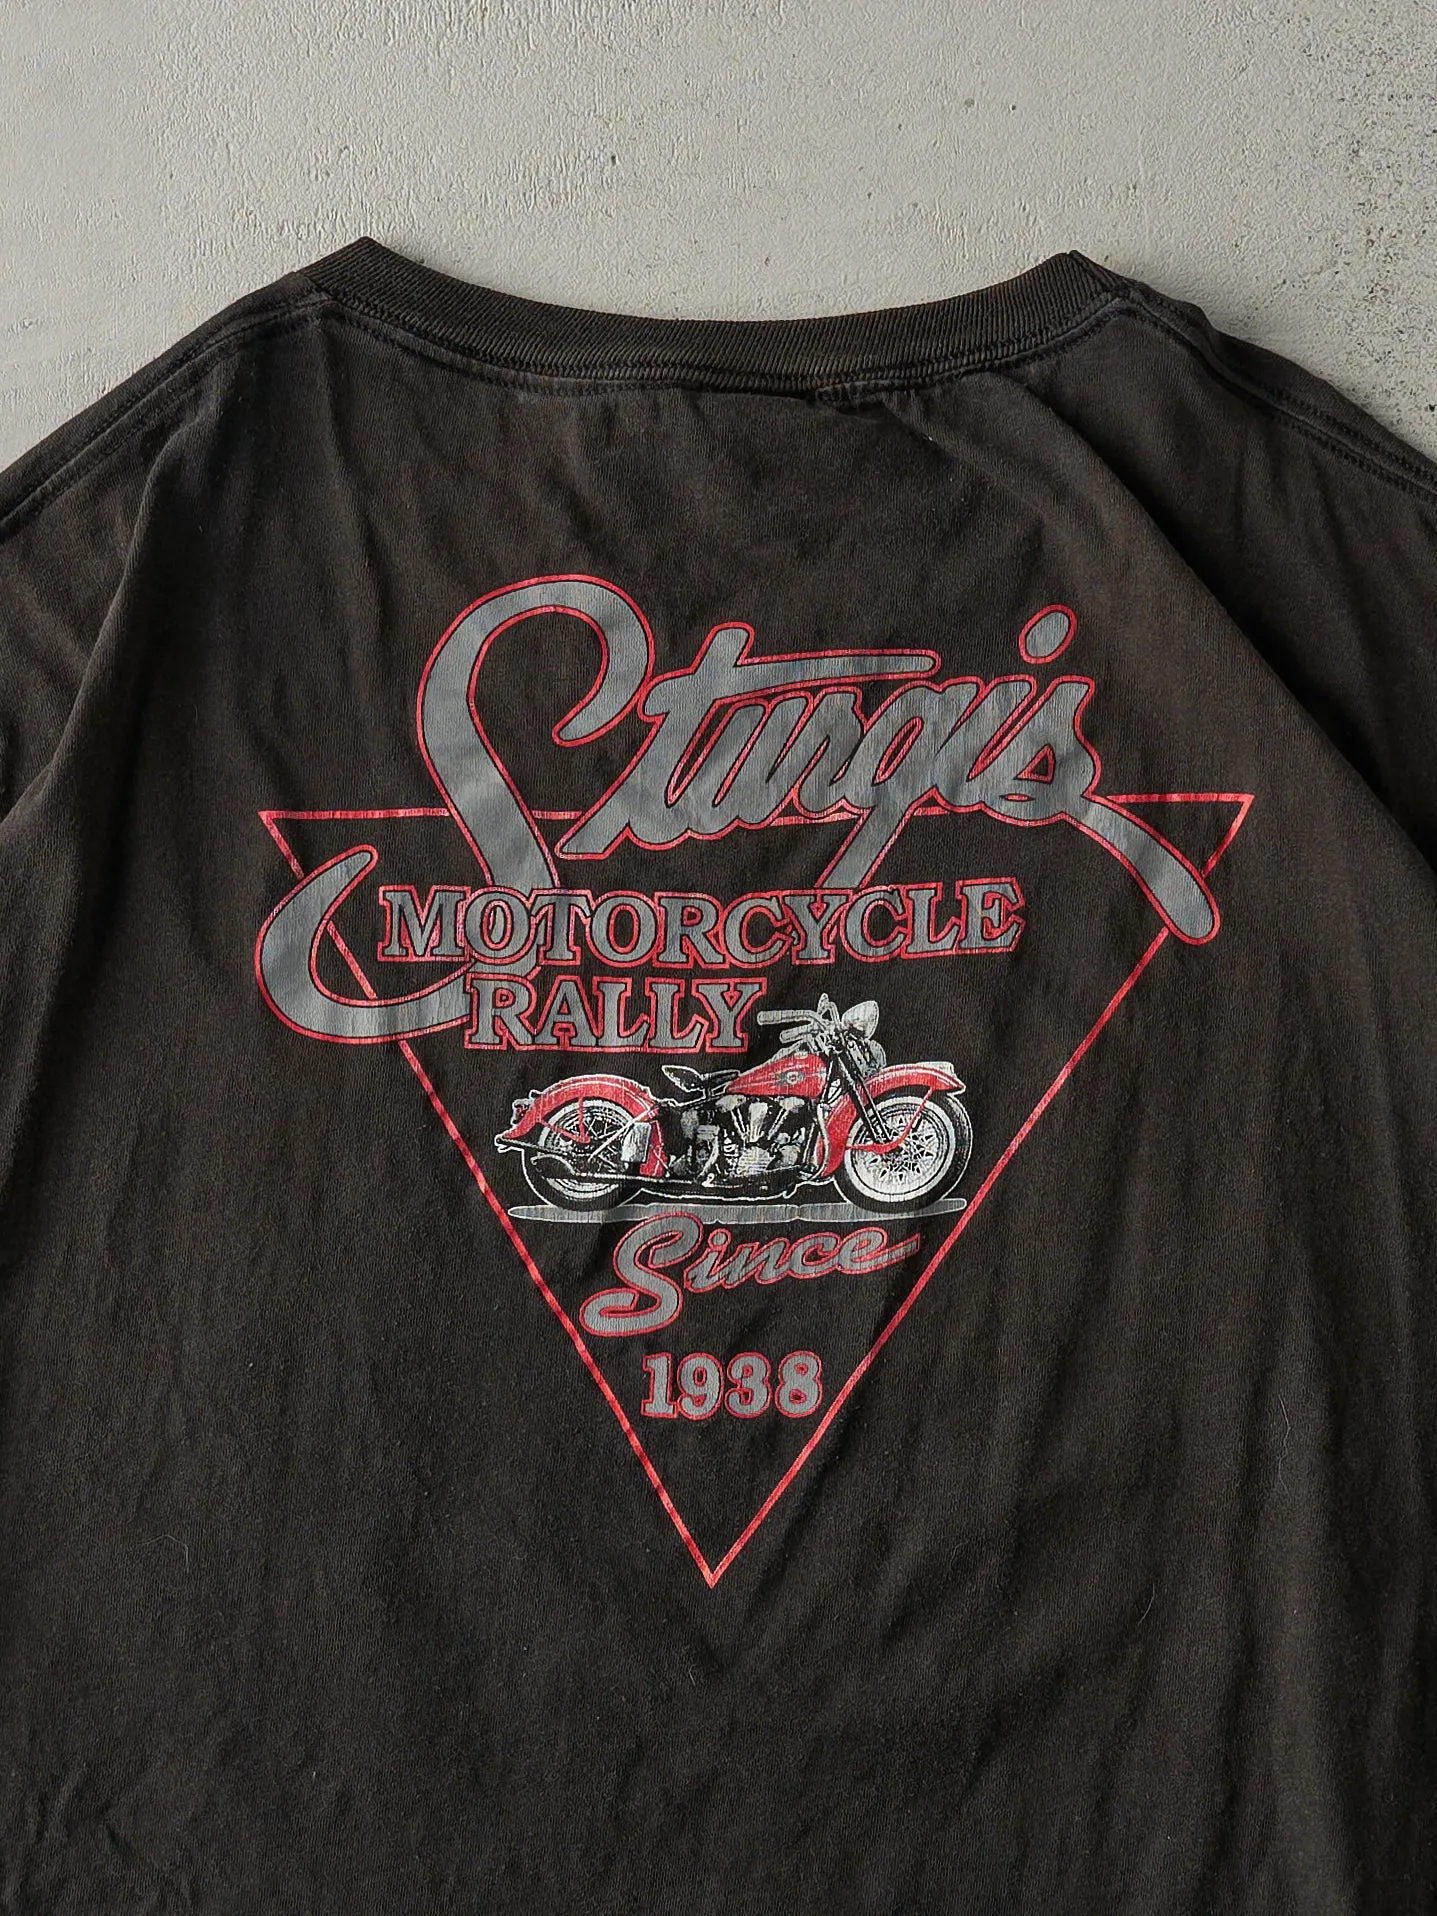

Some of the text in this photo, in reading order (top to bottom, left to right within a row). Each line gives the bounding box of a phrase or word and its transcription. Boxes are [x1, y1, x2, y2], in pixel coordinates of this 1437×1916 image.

[255, 573, 1221, 1043] Sturgis
[376, 875, 1026, 969] MOTORCYCLE
[462, 974, 768, 1054] RALLY
[579, 1211, 921, 1336] Since
[641, 1350, 824, 1421] 1938
